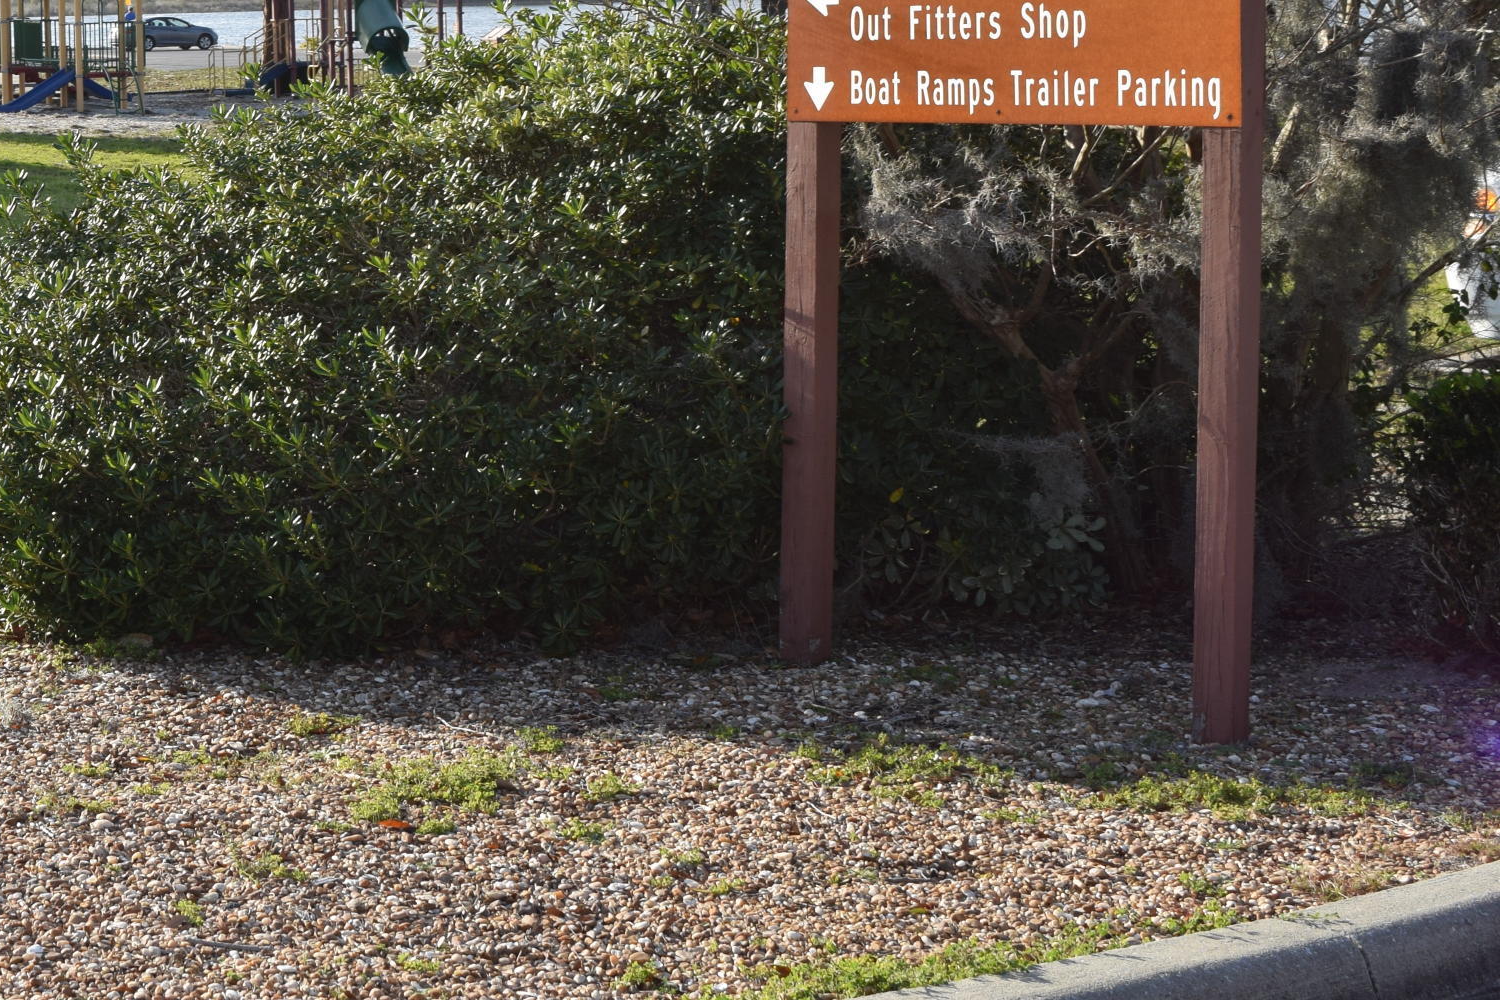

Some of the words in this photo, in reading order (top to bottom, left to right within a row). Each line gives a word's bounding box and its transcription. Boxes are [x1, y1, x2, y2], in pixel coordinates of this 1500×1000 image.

[850, 4, 892, 42] Out
[909, 4, 1002, 41] Fitters
[1020, 1, 1087, 49] Shop
[850, 69, 901, 106] Boat
[916, 69, 995, 116] Ramps
[1010, 69, 1100, 108] Trailer
[1117, 69, 1221, 121] Parking
